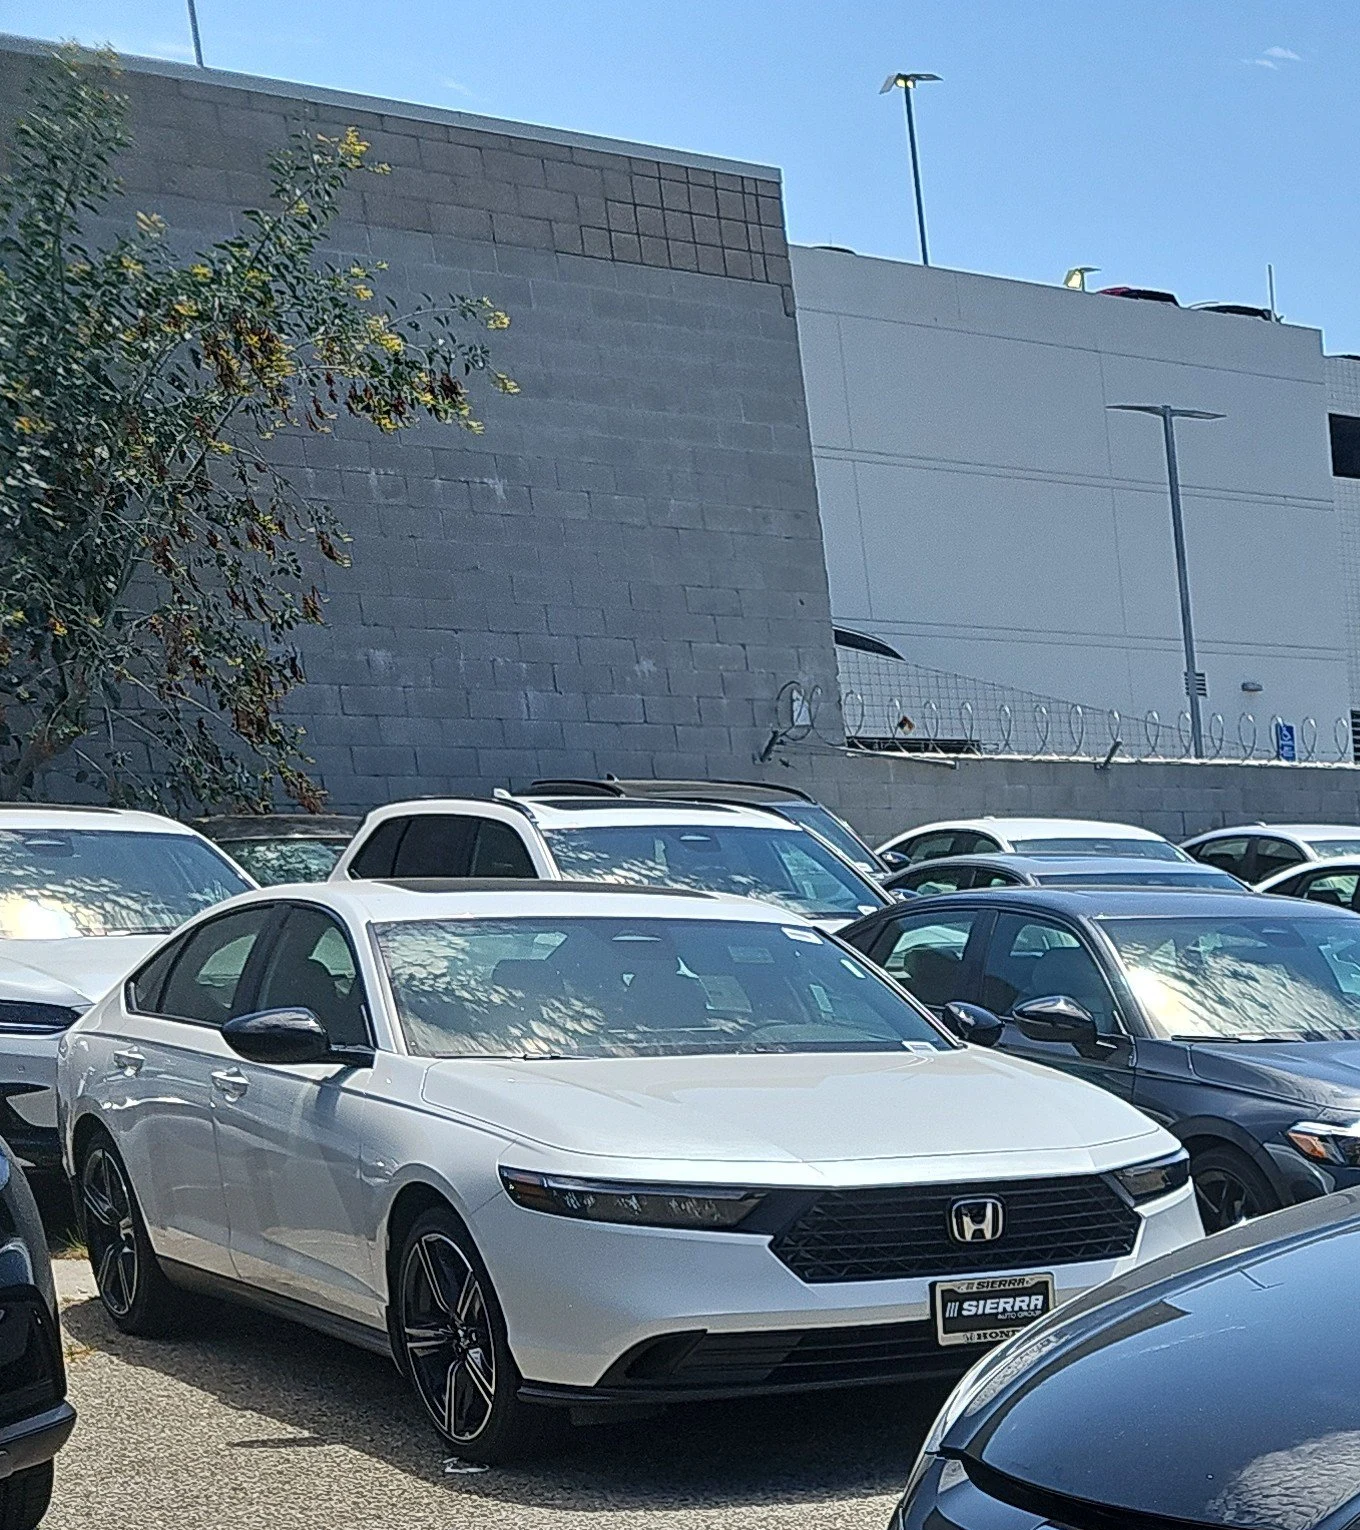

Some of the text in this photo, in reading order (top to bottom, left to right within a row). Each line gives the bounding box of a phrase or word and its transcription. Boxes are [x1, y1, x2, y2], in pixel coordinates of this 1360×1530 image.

[976, 1278, 1026, 1290] SIERRA
[962, 1295, 1043, 1316] SIERRA
[1017, 1310, 1042, 1318] GROUP
